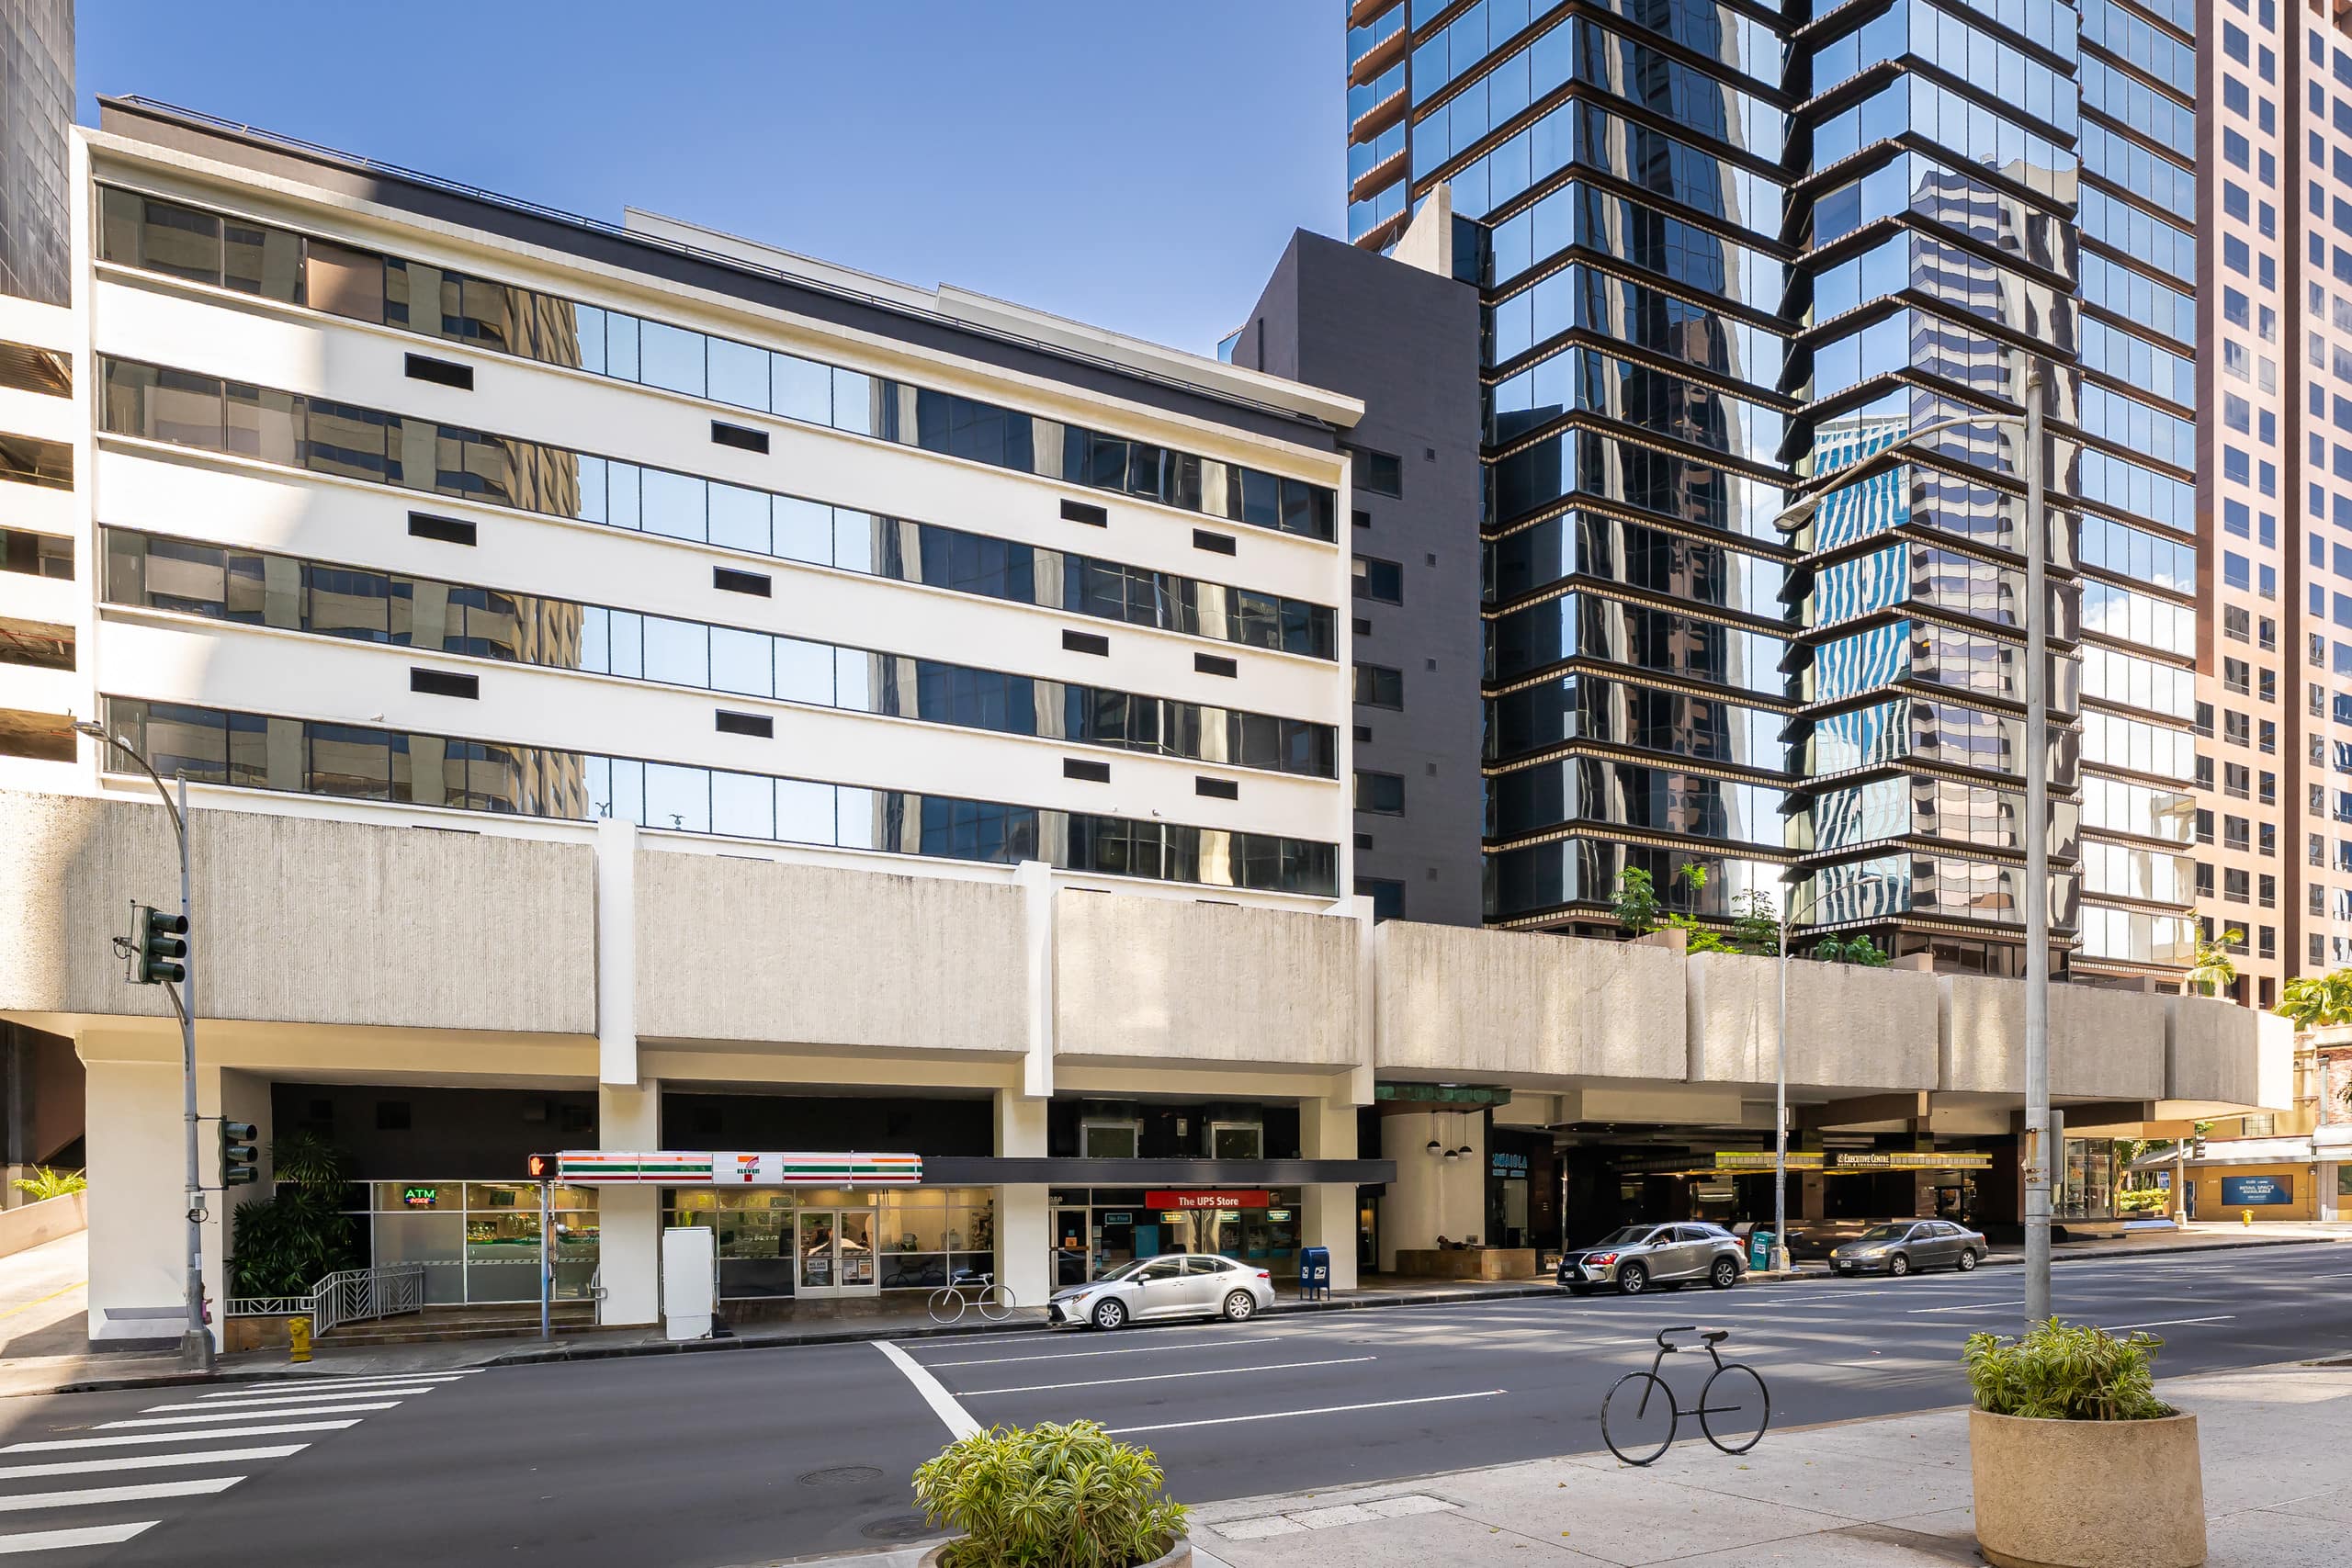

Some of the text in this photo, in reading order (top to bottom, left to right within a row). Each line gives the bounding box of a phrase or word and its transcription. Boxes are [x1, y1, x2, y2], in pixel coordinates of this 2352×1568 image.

[737, 1156, 759, 1169] 7
[1844, 1153, 1890, 1163] EXECUTIVE CENTRE
[405, 1189, 435, 1198] ATM
[1178, 1197, 1239, 1206] The UPS Store
